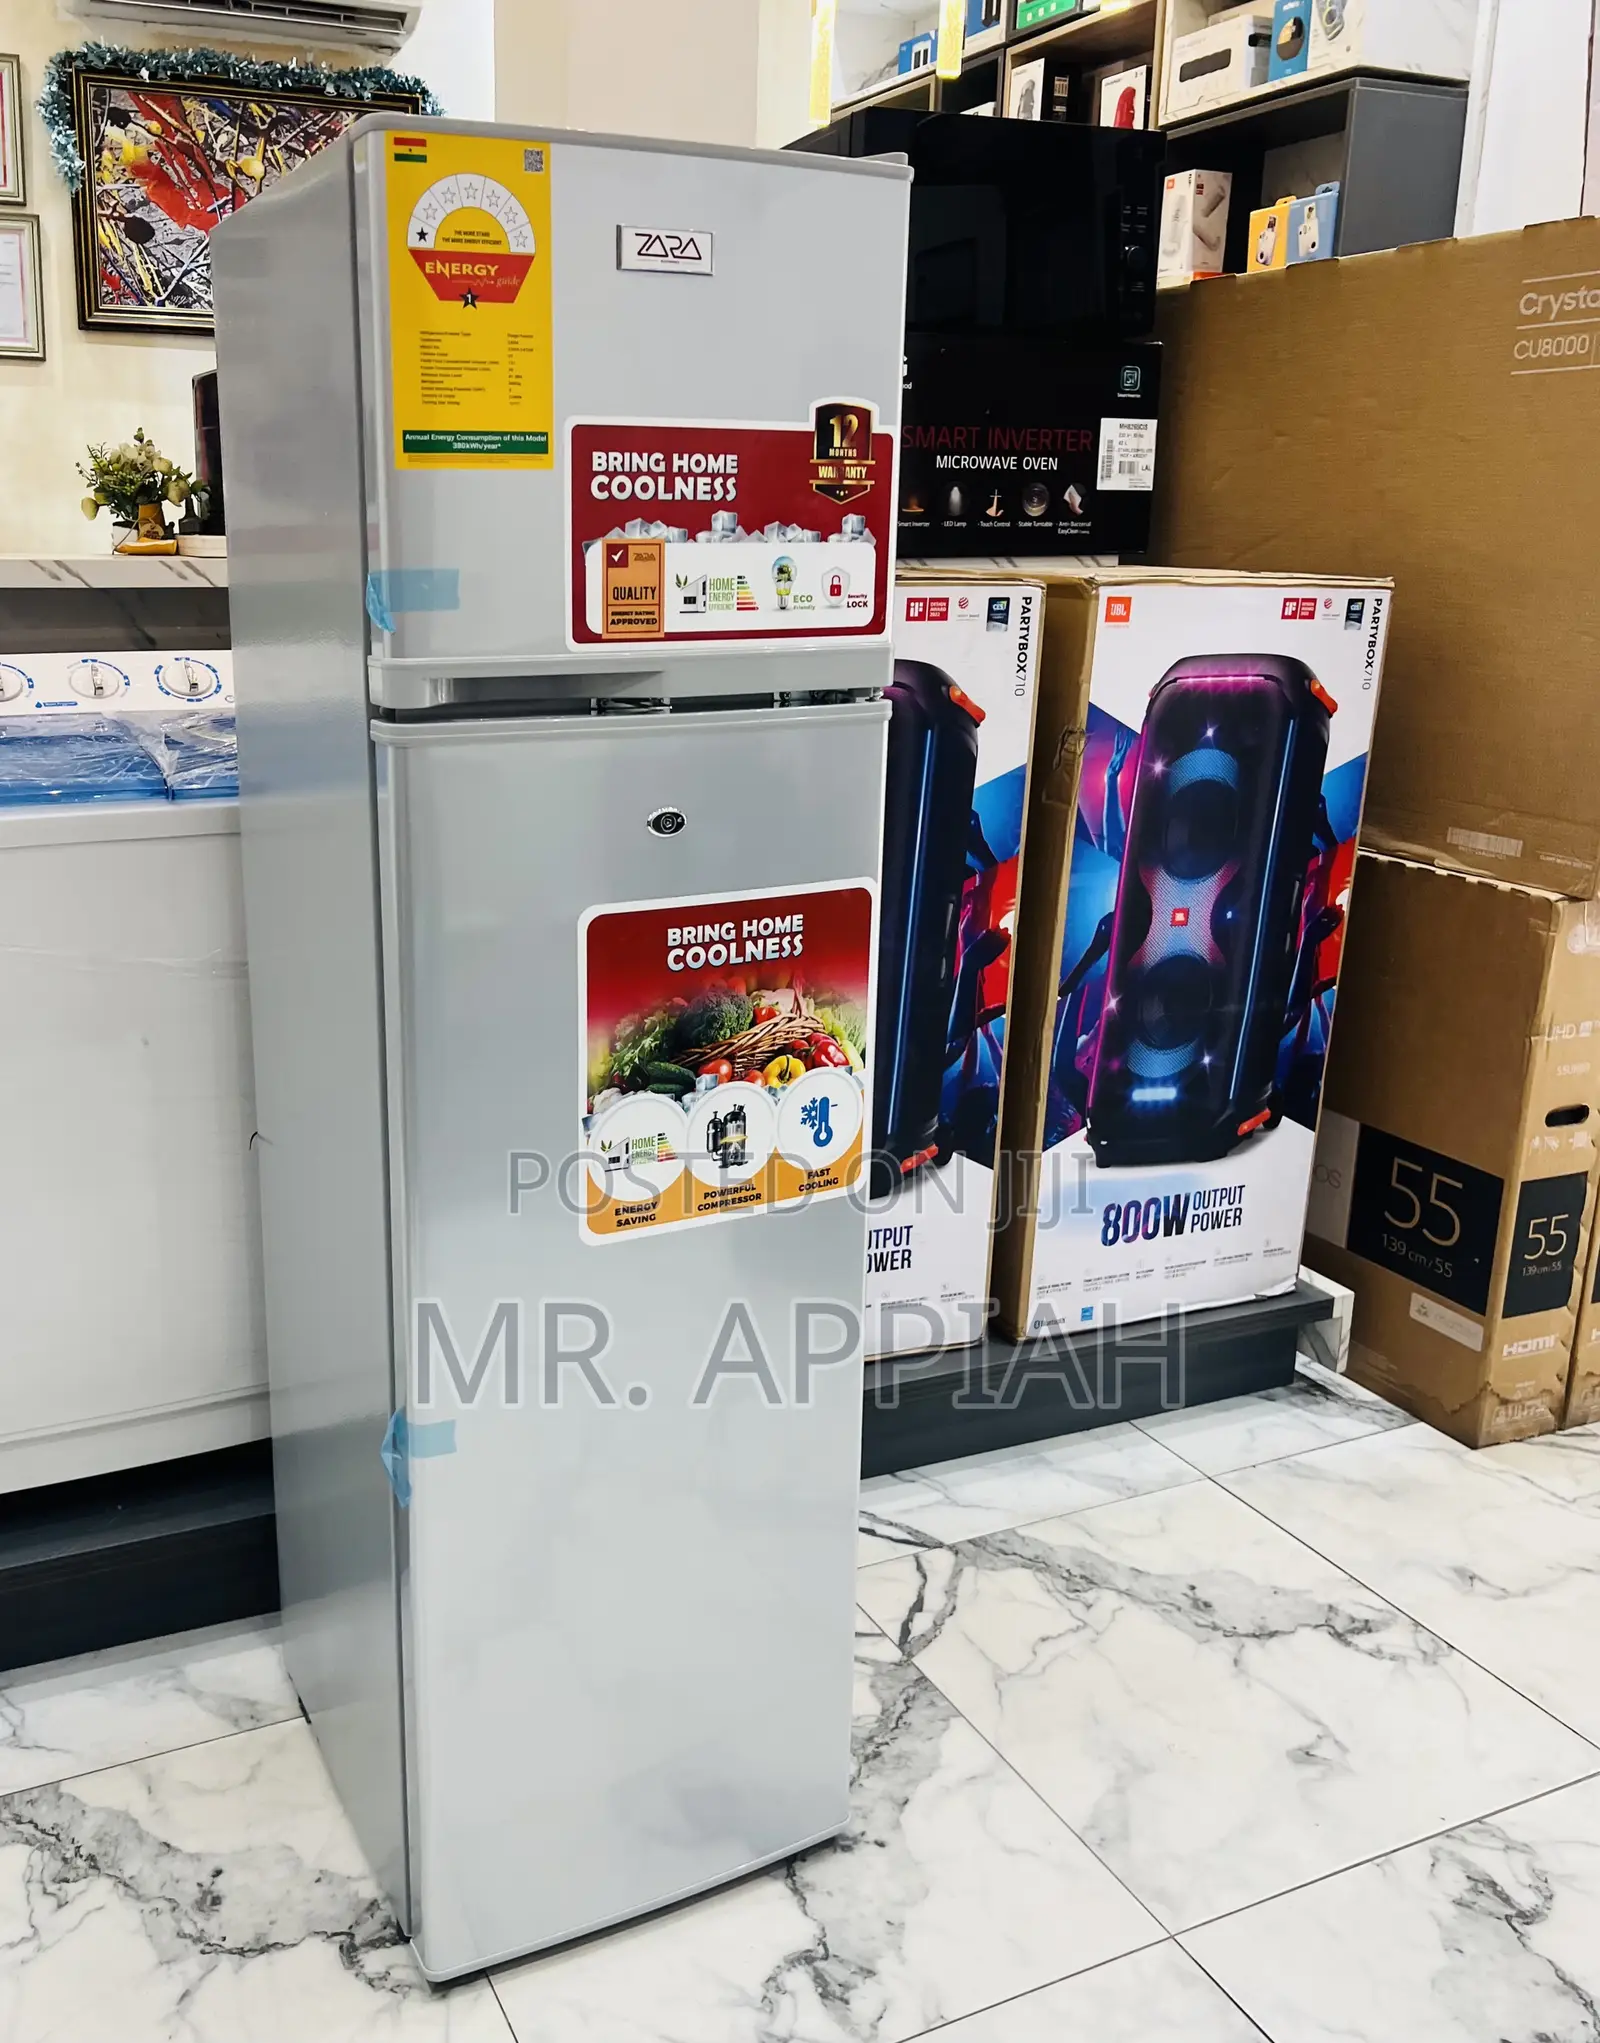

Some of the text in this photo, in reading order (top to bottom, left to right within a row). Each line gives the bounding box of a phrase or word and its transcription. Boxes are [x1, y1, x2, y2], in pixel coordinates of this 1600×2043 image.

[634, 232, 702, 260] ZARA
[425, 260, 499, 279] ENERGY
[466, 294, 472, 303] 1
[1514, 334, 1590, 359] CU8000
[829, 414, 858, 447] 12
[902, 425, 1093, 451] SMART INVERTER
[592, 451, 738, 474] BRING HOME
[829, 449, 857, 457] MONTHS
[936, 455, 1058, 470] MICROWAVE OVEN
[590, 475, 737, 502] COOLNESS
[613, 586, 656, 600] QUALITY
[709, 577, 735, 591] HOME
[709, 591, 735, 602] ENERGY
[793, 595, 813, 603] ECO
[1111, 604, 1127, 616] JBL
[610, 617, 657, 626] APPROVED
[667, 914, 803, 946] BRING HOME
[667, 934, 803, 971] COOLNESS
[632, 1136, 656, 1150] HOME
[807, 1168, 831, 1180] FAST
[703, 1184, 756, 1200] POWERFUL
[798, 1177, 839, 1192] COOLING
[697, 1193, 762, 1212] COMPRESSOR
[1193, 1184, 1246, 1211] OUTPUT
[1384, 1157, 1463, 1246] 55
[614, 1201, 658, 1216] ENERGY
[616, 1214, 656, 1227] SAVING
[1100, 1192, 1191, 1247] 800W
[1190, 1207, 1243, 1233] POWER
[1382, 1233, 1407, 1255] 139
[1524, 1214, 1569, 1260] 55
[1503, 1334, 1556, 1357] HDMI
